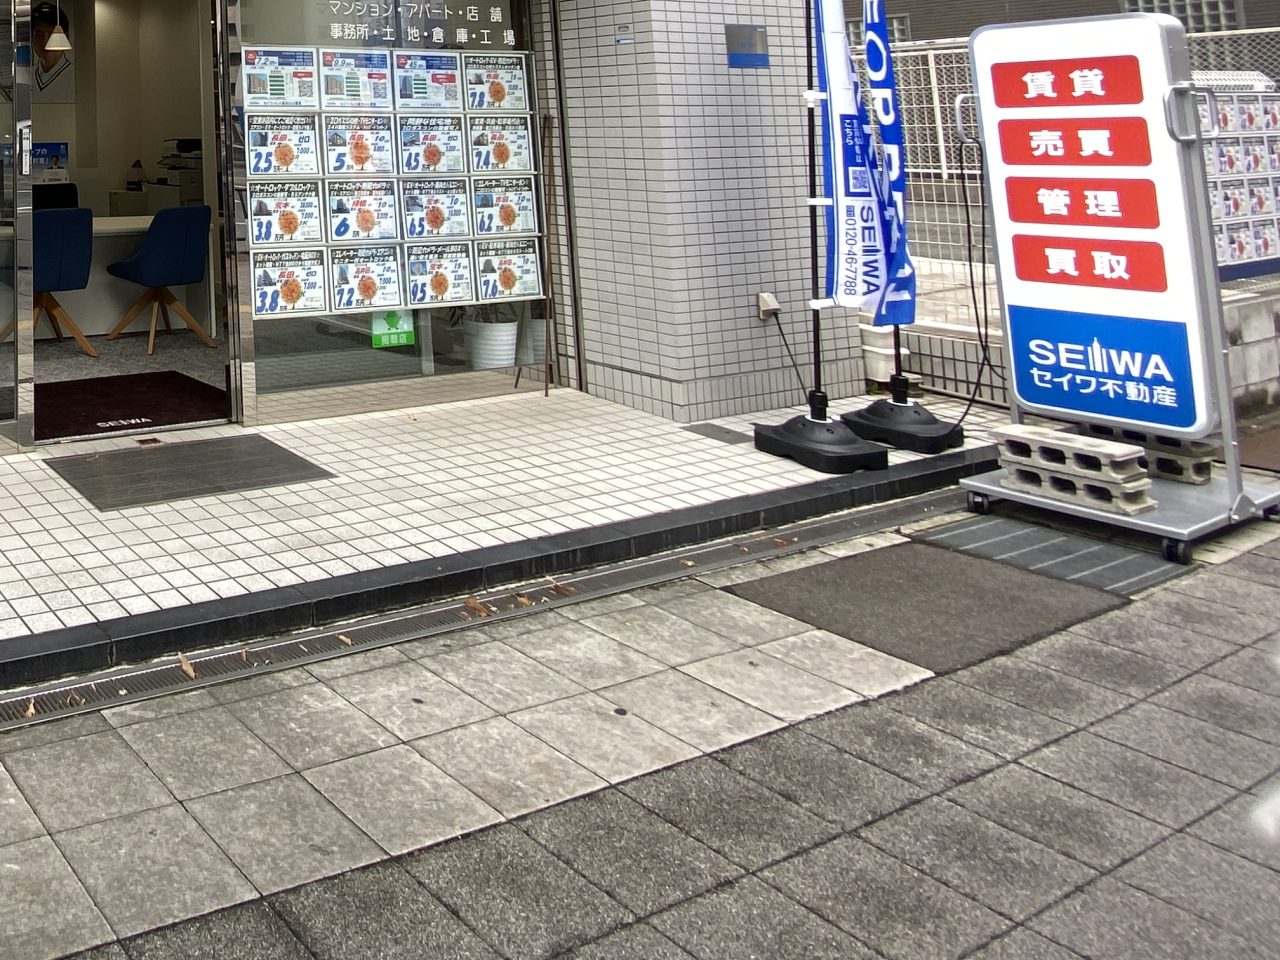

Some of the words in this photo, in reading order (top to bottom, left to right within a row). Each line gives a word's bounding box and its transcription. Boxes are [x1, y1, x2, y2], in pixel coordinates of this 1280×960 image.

[1022, 68, 1105, 99] 賃貸
[1029, 129, 1114, 157] 売買
[253, 151, 273, 173] 2.5
[1036, 188, 1122, 217] 管理
[255, 220, 273, 242] 3.8
[334, 217, 350, 237] 6
[844, 218, 859, 297] 0120-46-7788
[1044, 247, 1130, 280] 買取
[257, 290, 280, 313] 3.8
[1030, 367, 1178, 408] セイワ不動産
